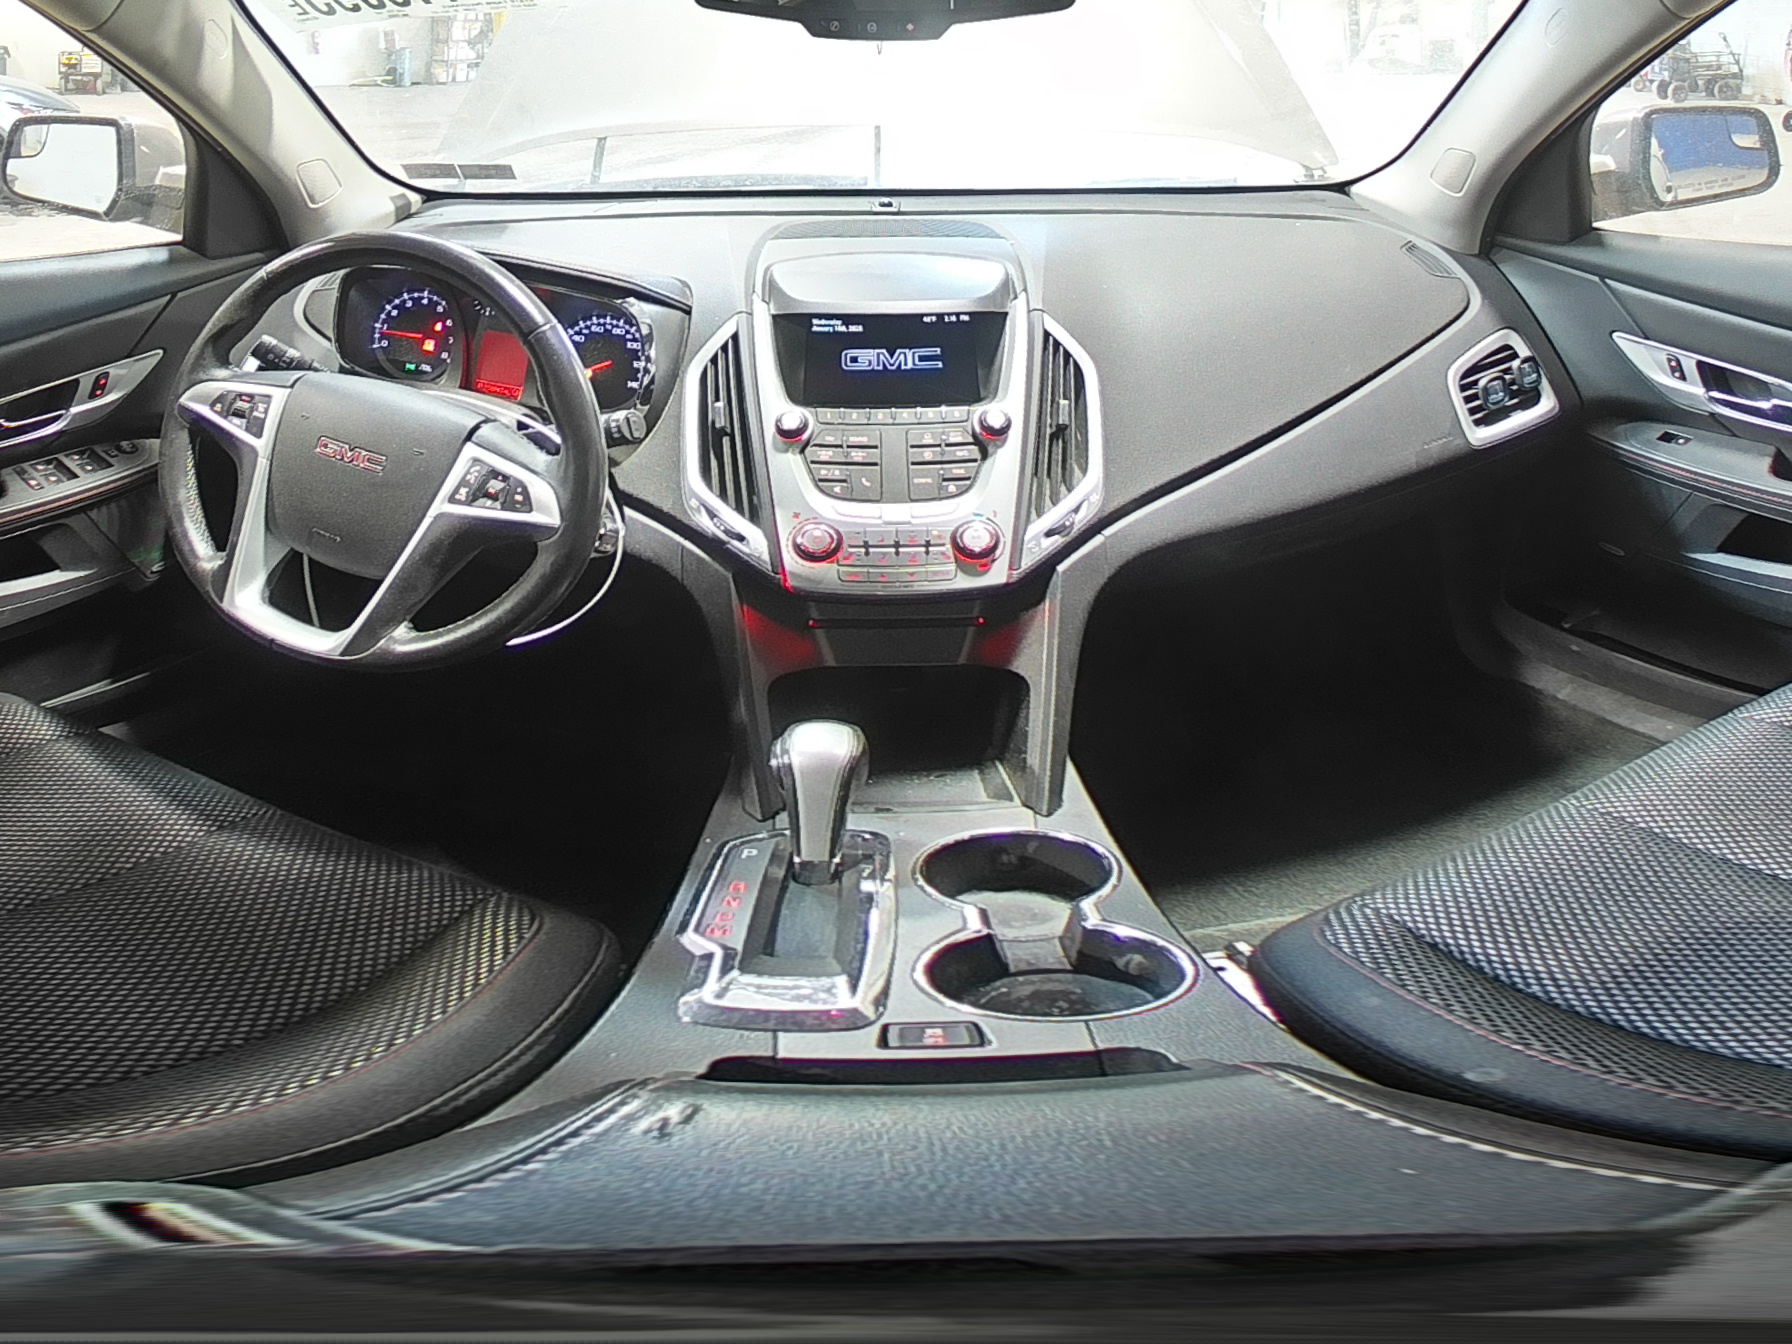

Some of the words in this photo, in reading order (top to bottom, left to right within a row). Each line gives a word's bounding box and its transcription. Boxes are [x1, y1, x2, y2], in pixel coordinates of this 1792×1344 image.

[840, 347, 944, 371] GMC
[314, 436, 386, 476] GMC
[740, 848, 759, 859] P
